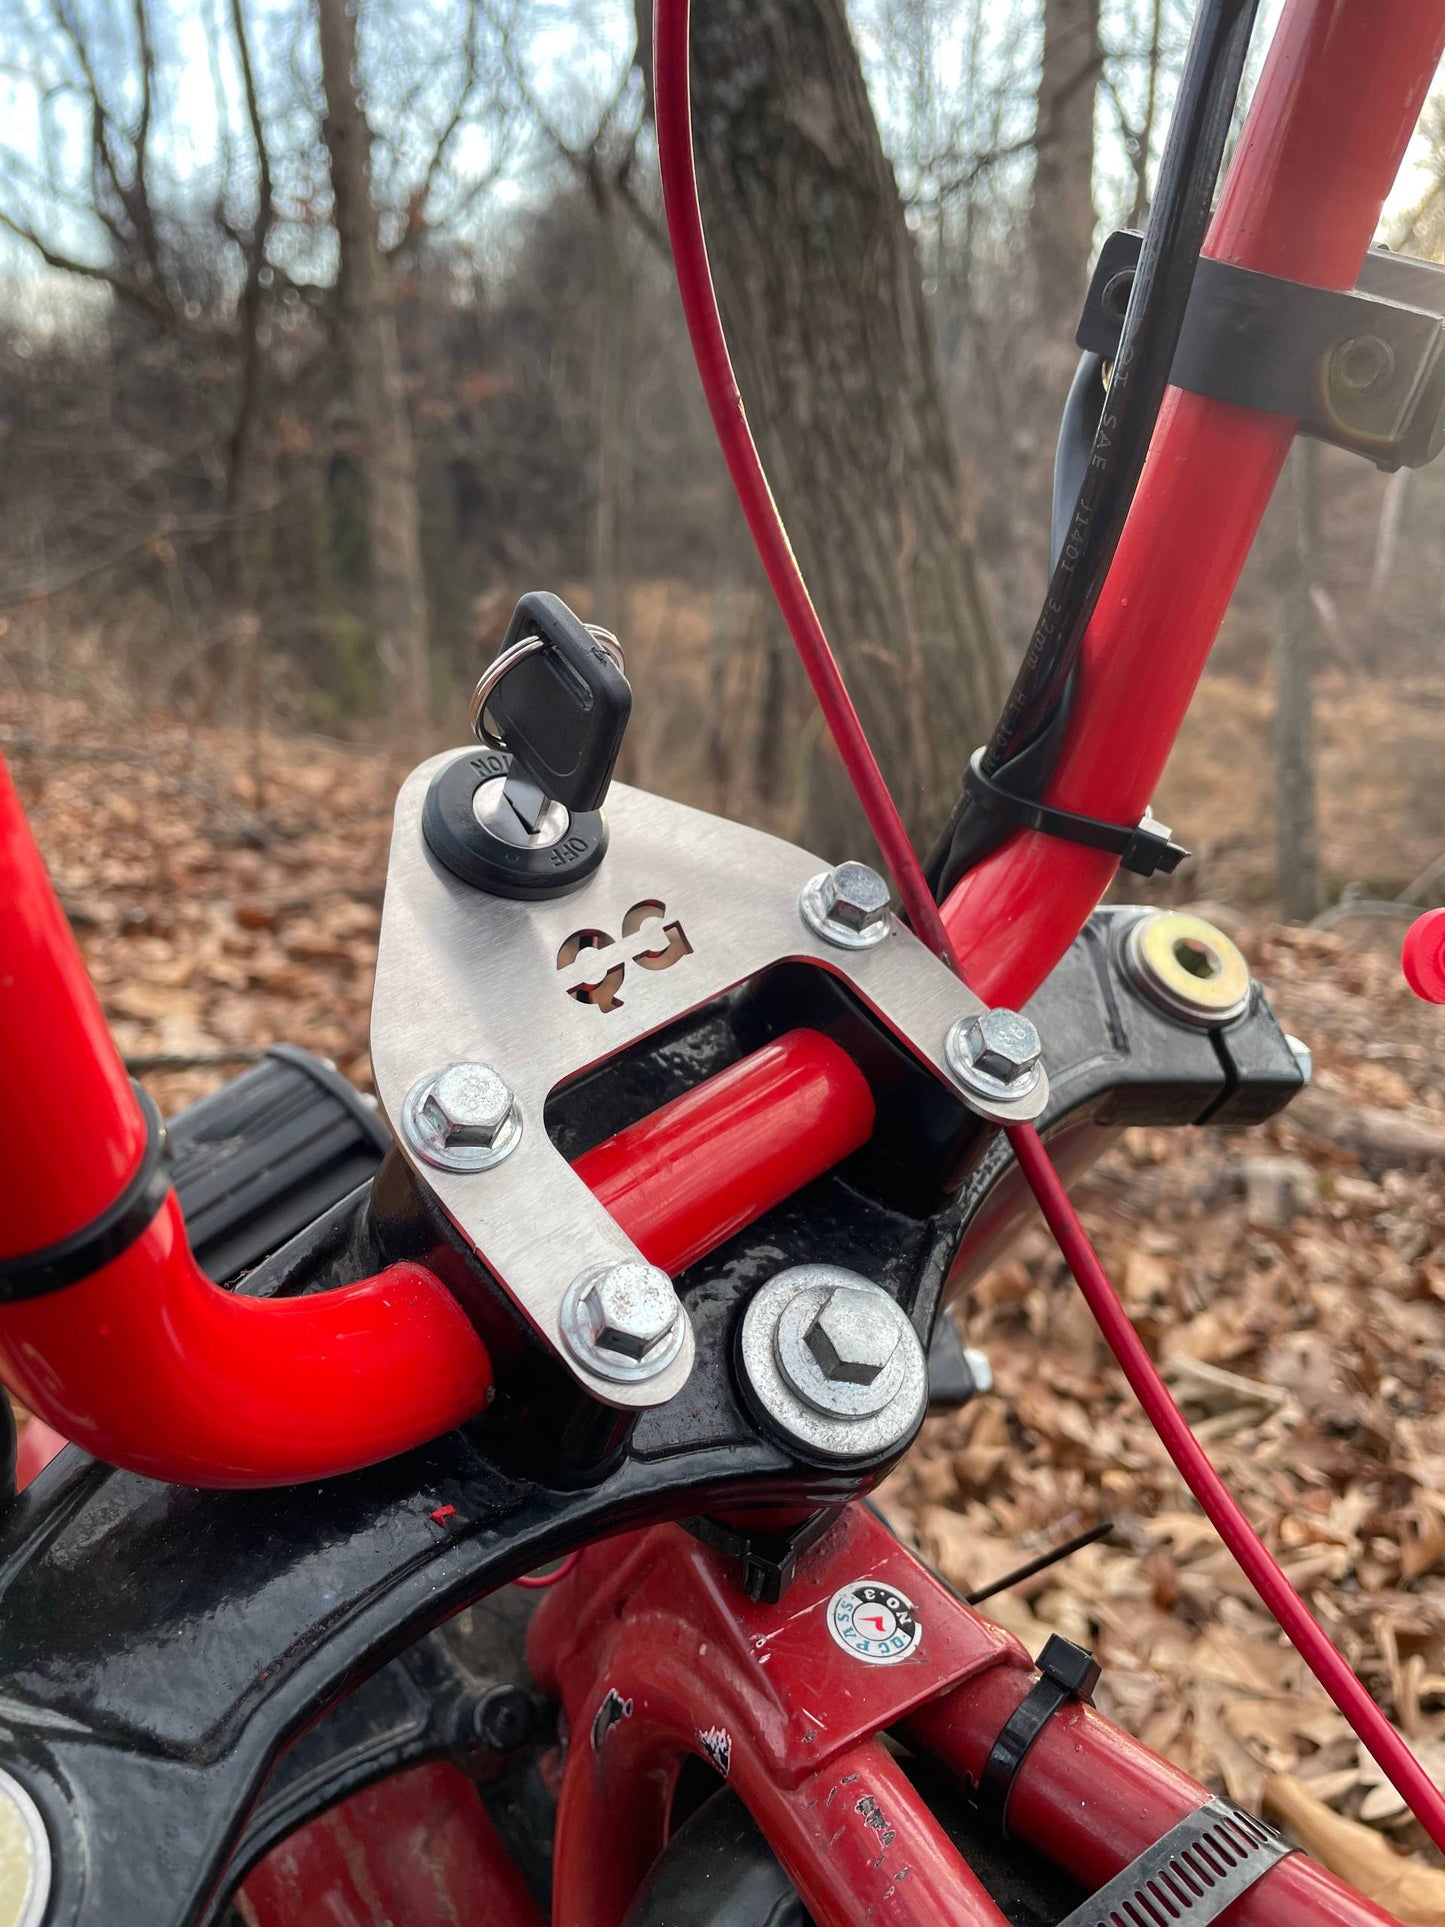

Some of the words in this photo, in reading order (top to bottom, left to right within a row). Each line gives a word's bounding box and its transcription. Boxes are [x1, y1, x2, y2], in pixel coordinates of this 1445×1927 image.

[1091, 412, 1117, 471] SAE
[1061, 498, 1093, 573] J1401
[549, 836, 589, 868] OFF
[837, 1600, 871, 1652] PASS
